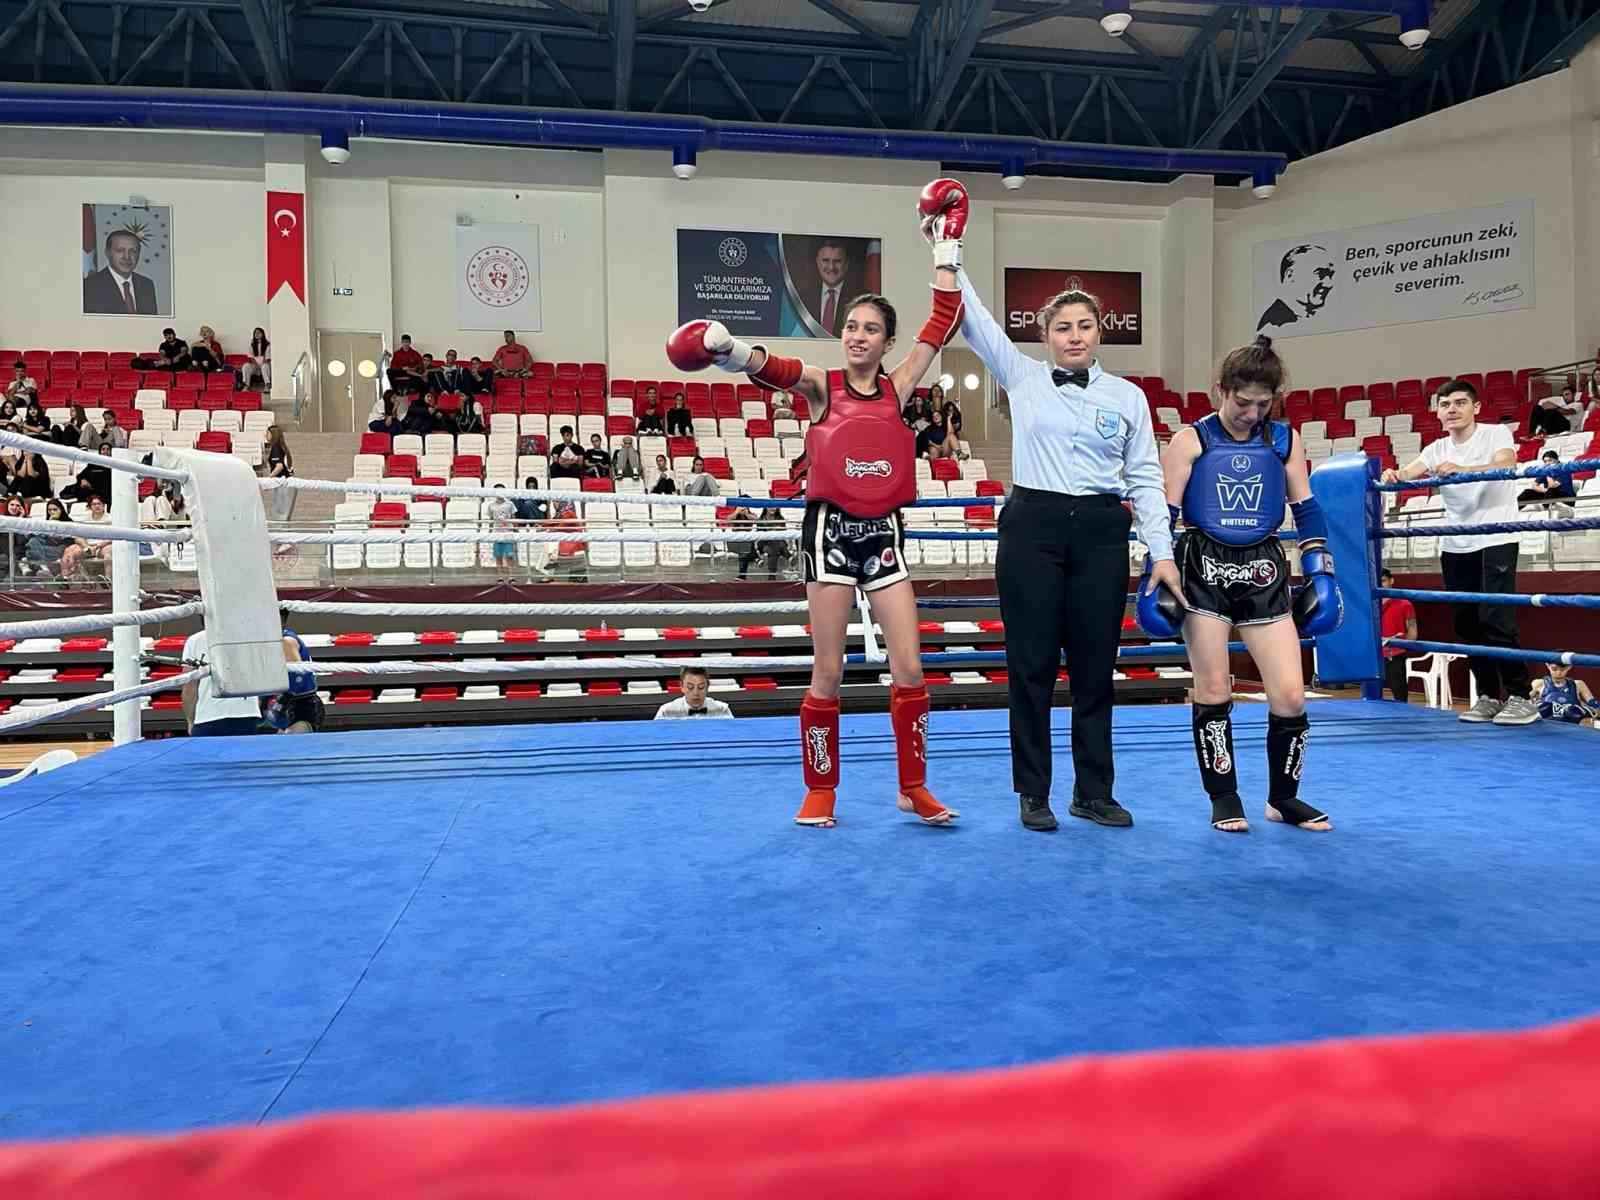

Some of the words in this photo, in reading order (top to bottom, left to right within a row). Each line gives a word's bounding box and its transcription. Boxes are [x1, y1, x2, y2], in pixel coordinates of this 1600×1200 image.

[1345, 246, 1380, 261] Ben,
[1385, 231, 1473, 256] sporcunun
[1478, 221, 1518, 240] zeki,
[1353, 261, 1395, 282] çevik
[1400, 260, 1418, 272] ve
[1423, 247, 1510, 270] ahlaklısını
[703, 274, 720, 284] TÜM
[722, 276, 764, 285] ANTRENÖR
[1394, 273, 1465, 293] severim.
[694, 283, 704, 291] VE
[705, 283, 773, 293] SPORCULARIMIZA
[697, 292, 733, 300] BAŞARILAR
